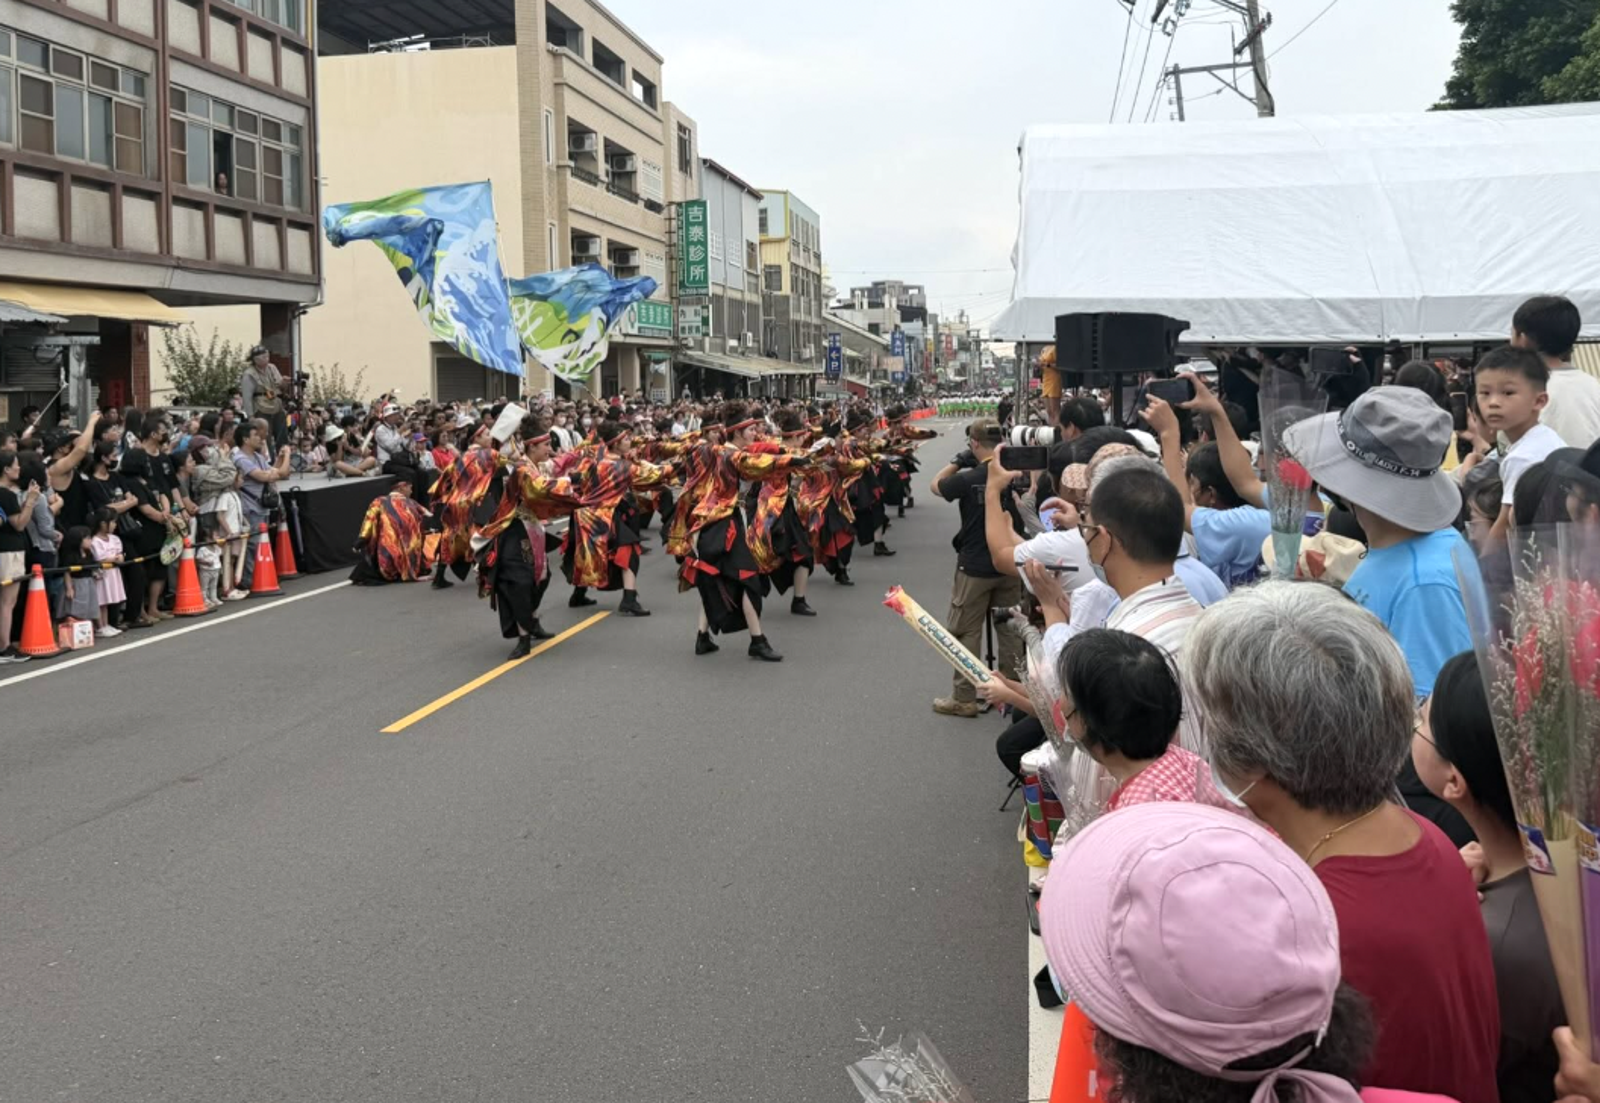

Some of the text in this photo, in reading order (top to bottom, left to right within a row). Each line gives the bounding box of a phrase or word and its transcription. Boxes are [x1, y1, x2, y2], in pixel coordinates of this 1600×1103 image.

[688, 205, 705, 281] 吉泰診所
[831, 361, 839, 370] P
